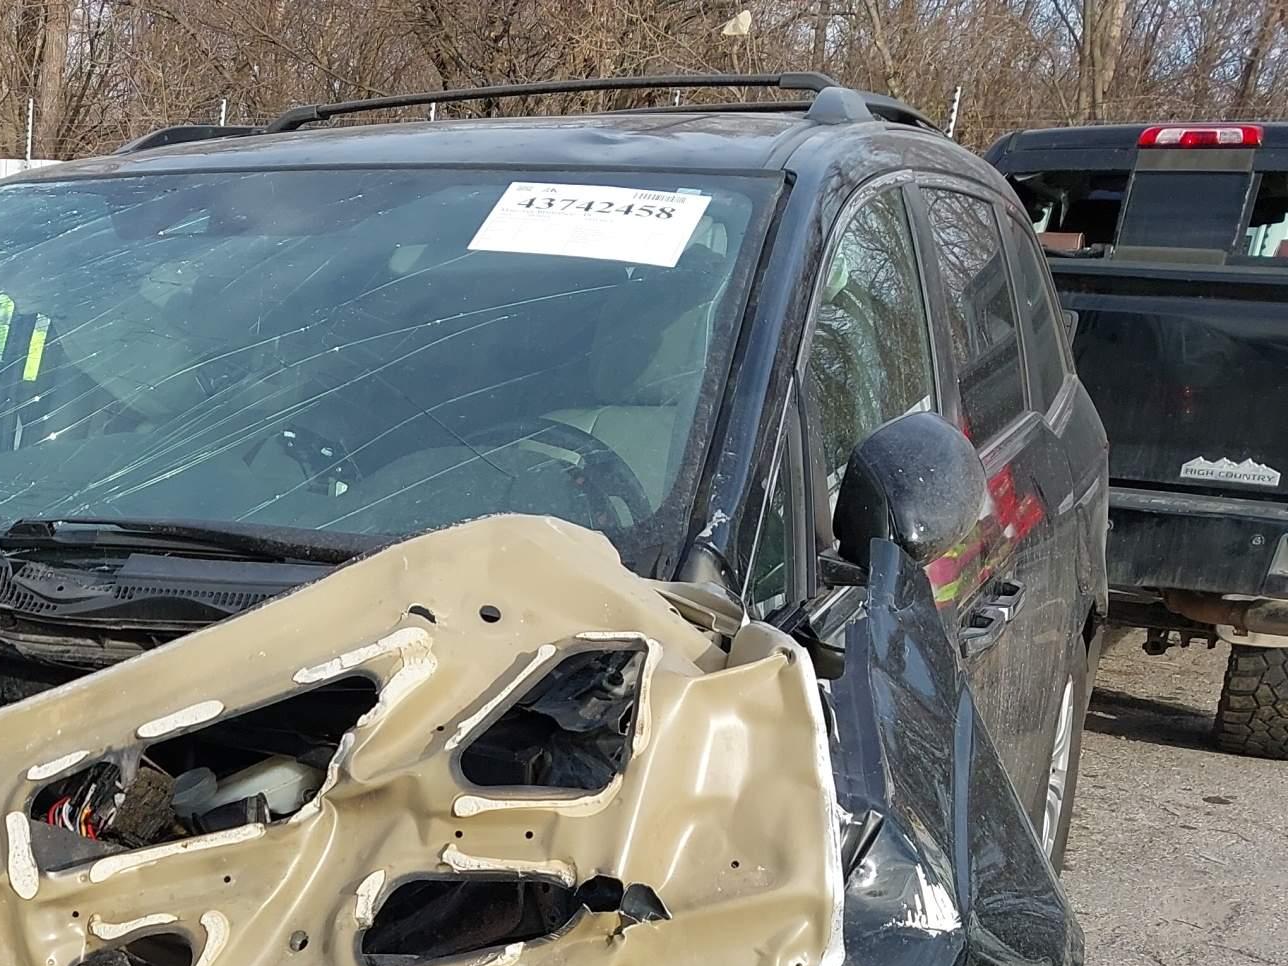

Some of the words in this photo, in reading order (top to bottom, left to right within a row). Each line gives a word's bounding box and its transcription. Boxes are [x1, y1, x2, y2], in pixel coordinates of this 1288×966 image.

[516, 196, 676, 220] 43742458
[1184, 467, 1214, 477] HIGH
[1218, 470, 1275, 482] COUNTRY
